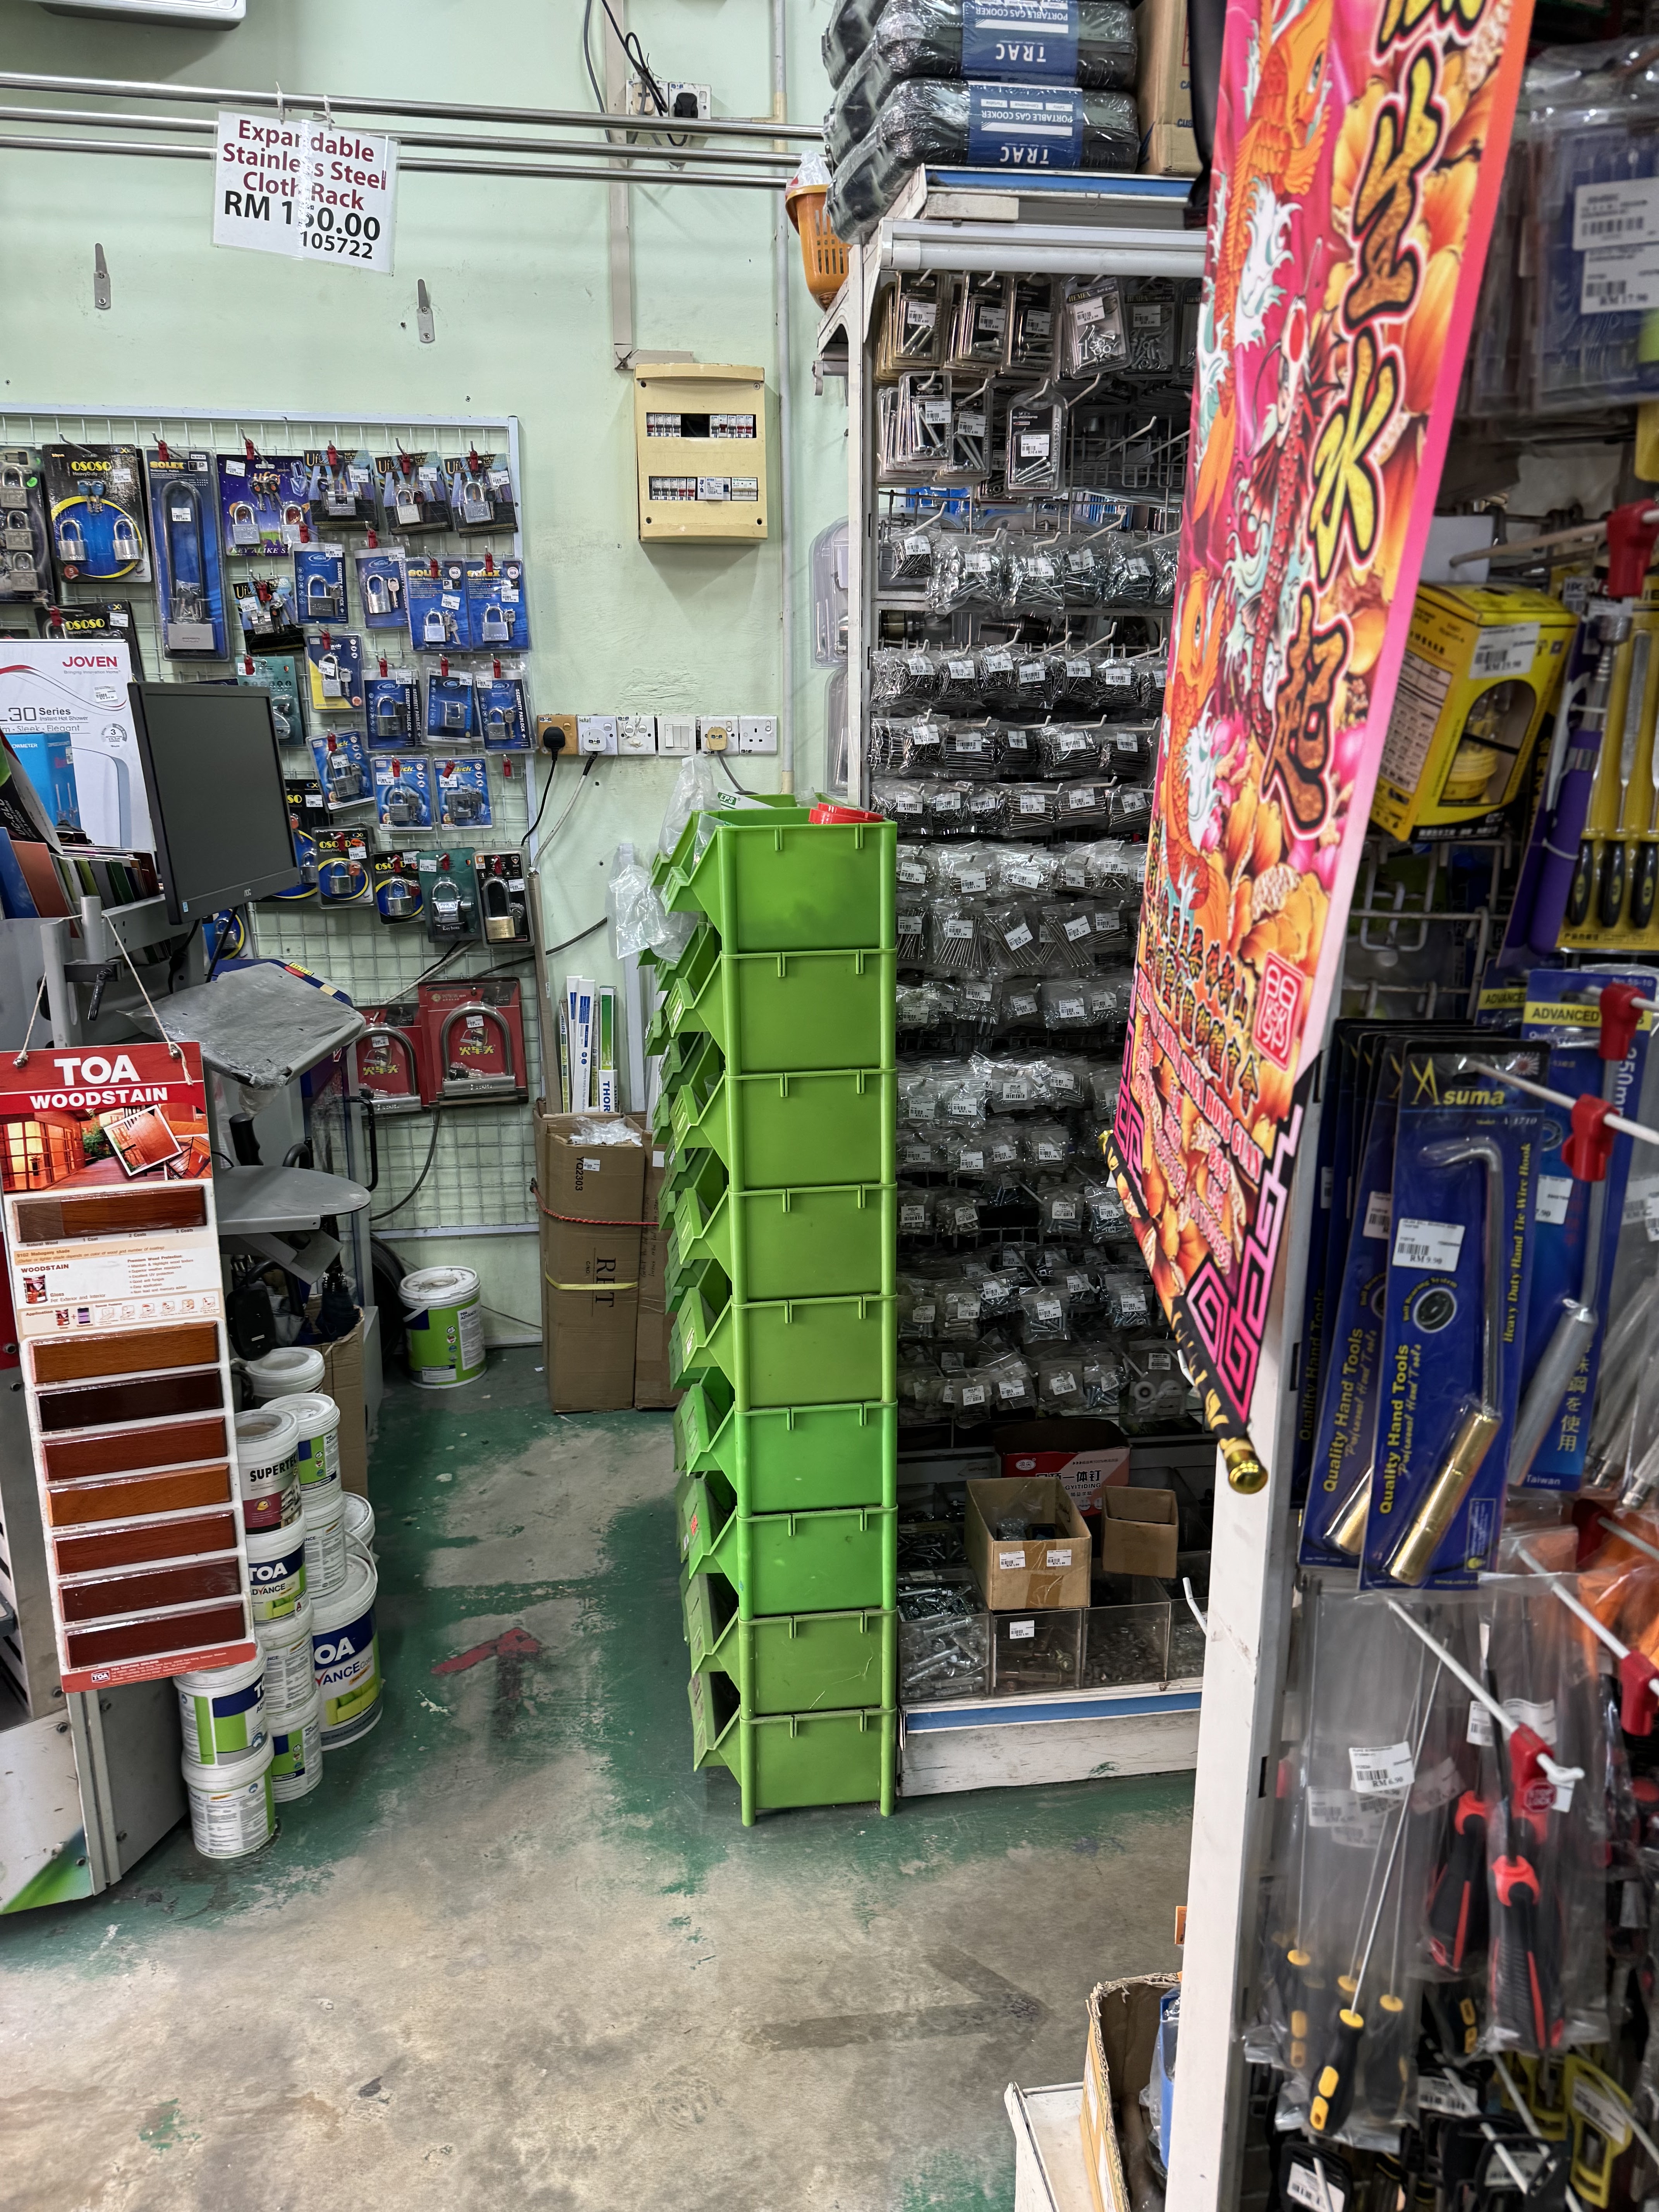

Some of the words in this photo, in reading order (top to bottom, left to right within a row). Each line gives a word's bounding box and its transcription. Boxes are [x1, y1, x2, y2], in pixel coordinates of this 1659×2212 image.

[976, 7, 1008, 16] COOKER
[1010, 9, 1026, 18] GAS
[1028, 11, 1068, 21] PORTABLE
[996, 44, 1046, 62] TRAC
[981, 110, 1013, 120] COOKER
[1016, 112, 1030, 121] GAS
[1033, 113, 1073, 123] PORTABLE
[1000, 146, 1049, 165] TRAC
[223, 143, 324, 177] Stainles
[330, 161, 386, 190] Steel
[225, 190, 270, 222] RM
[311, 182, 365, 211] Rack
[300, 231, 373, 259] 105722
[71, 461, 111, 471] OSOSO
[66, 619, 105, 630] OSOSO
[62, 656, 118, 667] JOVEN
[719, 794, 735, 804] EPS
[319, 840, 351, 848] OSOO
[1486, 992, 1525, 1005] ADVANCE
[1532, 1007, 1601, 1022] ADVANCED
[459, 1045, 495, 1056] 火车头
[54, 1055, 141, 1086] TOA
[363, 1064, 399, 1076] 火车头
[29, 1087, 168, 1109] WOODSTAIN
[1518, 1143, 1531, 1175] Hook
[575, 1156, 584, 1191] YQ2303
[1516, 1179, 1528, 1209] Wire
[1514, 1213, 1525, 1231] Tie
[1410, 1254, 1425, 1262] RM
[1511, 1236, 1523, 1269] Hand
[21, 1264, 69, 1273] WOODSTAIN
[1508, 1274, 1522, 1302] Duty
[1503, 1307, 1519, 1342] Heavy
[1343, 1328, 1363, 1374] Tools
[1393, 1345, 1409, 1393] Tools
[1334, 1381, 1355, 1427] Hand
[1388, 1400, 1404, 1446] Hand
[1323, 1432, 1348, 1492] Quality
[1379, 1450, 1401, 1514] Quality
[1526, 1474, 1561, 1486] Taiwan
[314, 1637, 356, 1664] OA
[315, 1661, 360, 1686] VANCE
